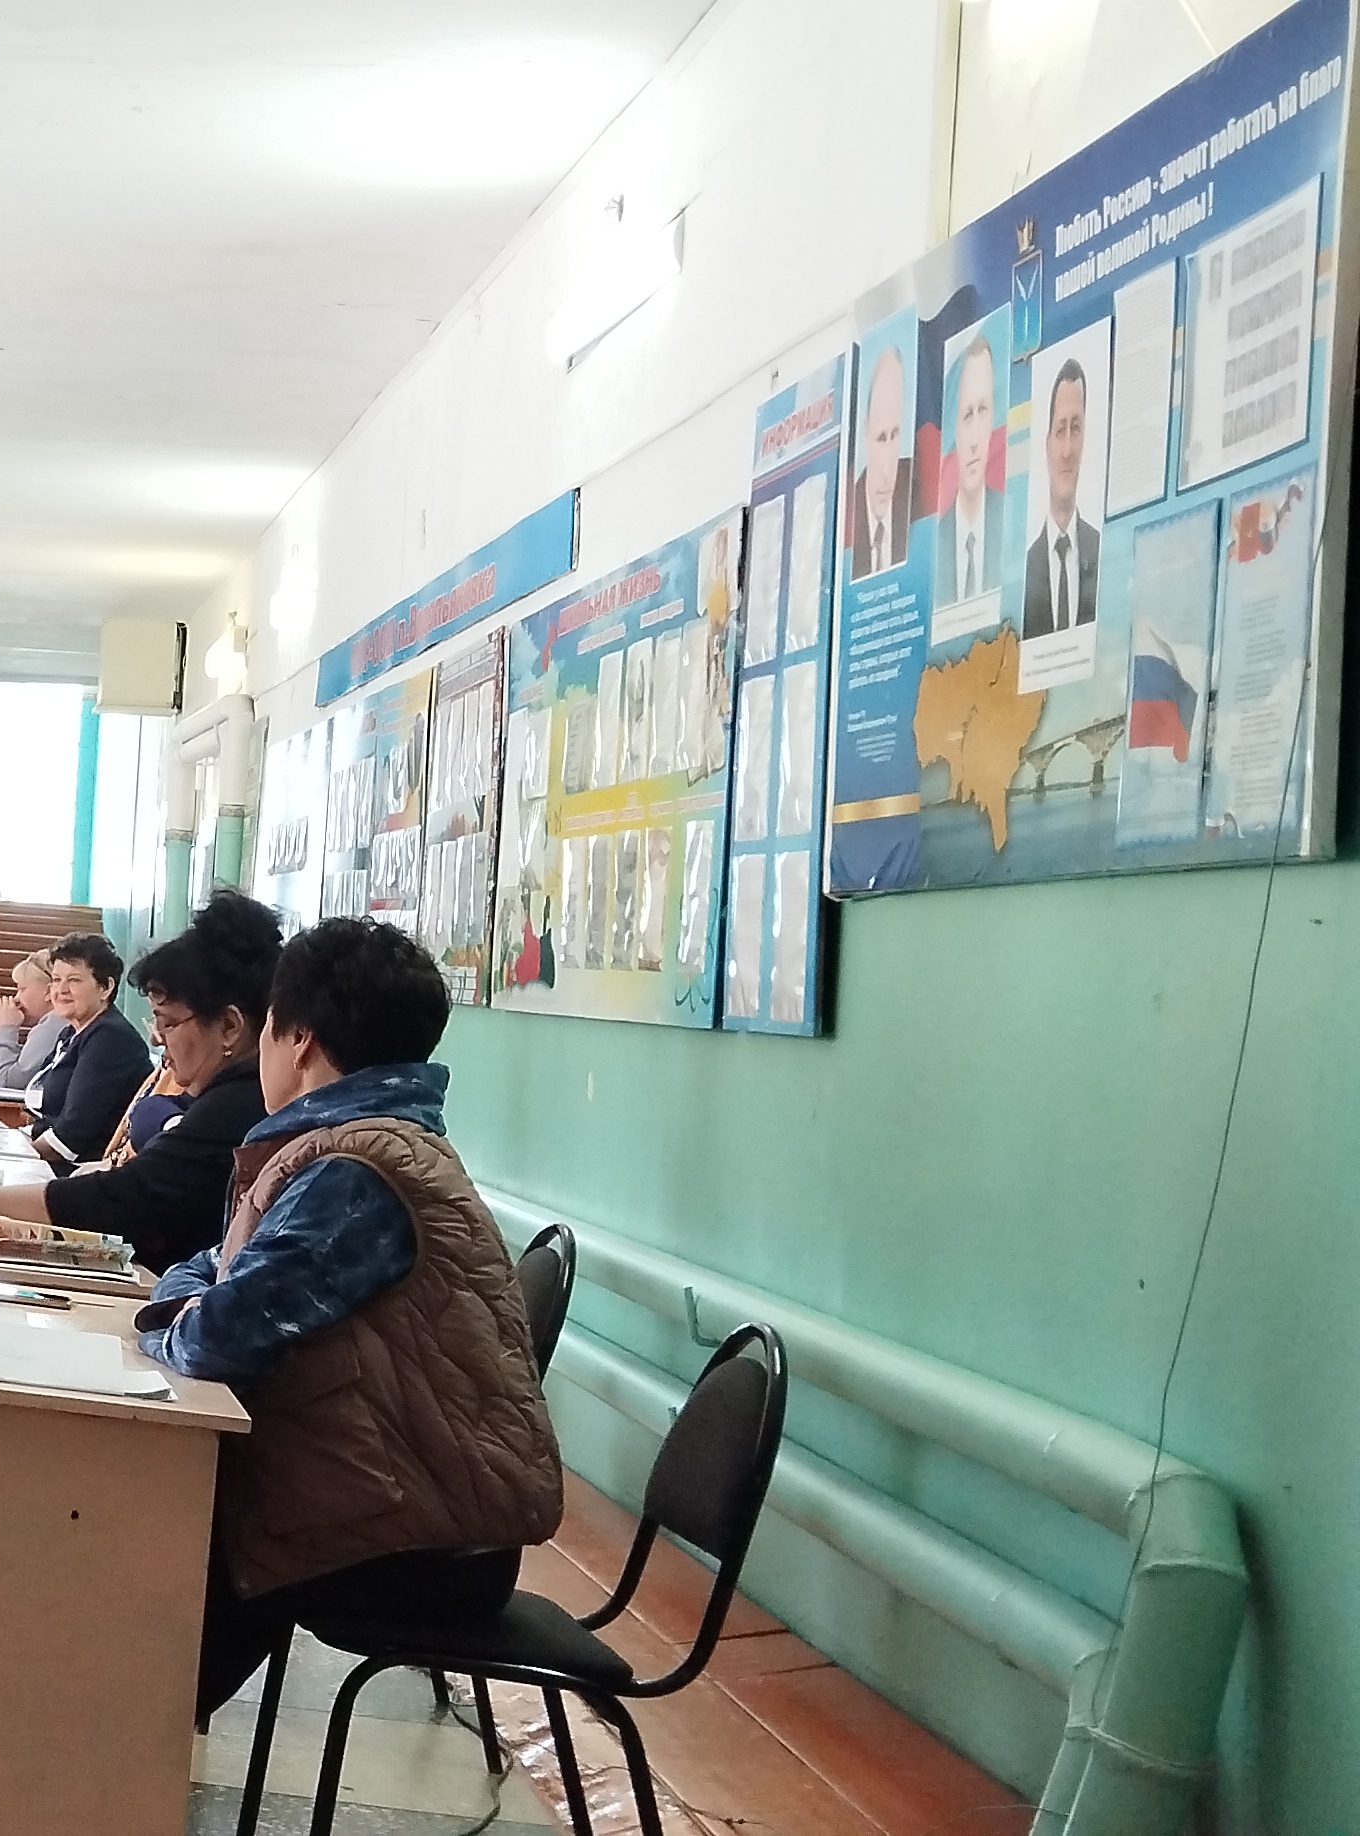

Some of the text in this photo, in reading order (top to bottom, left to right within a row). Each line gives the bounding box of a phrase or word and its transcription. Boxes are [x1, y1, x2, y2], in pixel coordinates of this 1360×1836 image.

[1055, 208, 1102, 257] Любить
[1103, 176, 1151, 229] Россию
[1160, 141, 1208, 194] значит
[1210, 101, 1277, 169] работать
[1278, 85, 1298, 124] на
[1299, 55, 1342, 110] благо
[1055, 251, 1095, 303] нашей
[1096, 218, 1150, 279] великой
[762, 389, 835, 458] ИНФОРМАЦИЯ
[617, 566, 662, 609] ЖИЗНЬ
